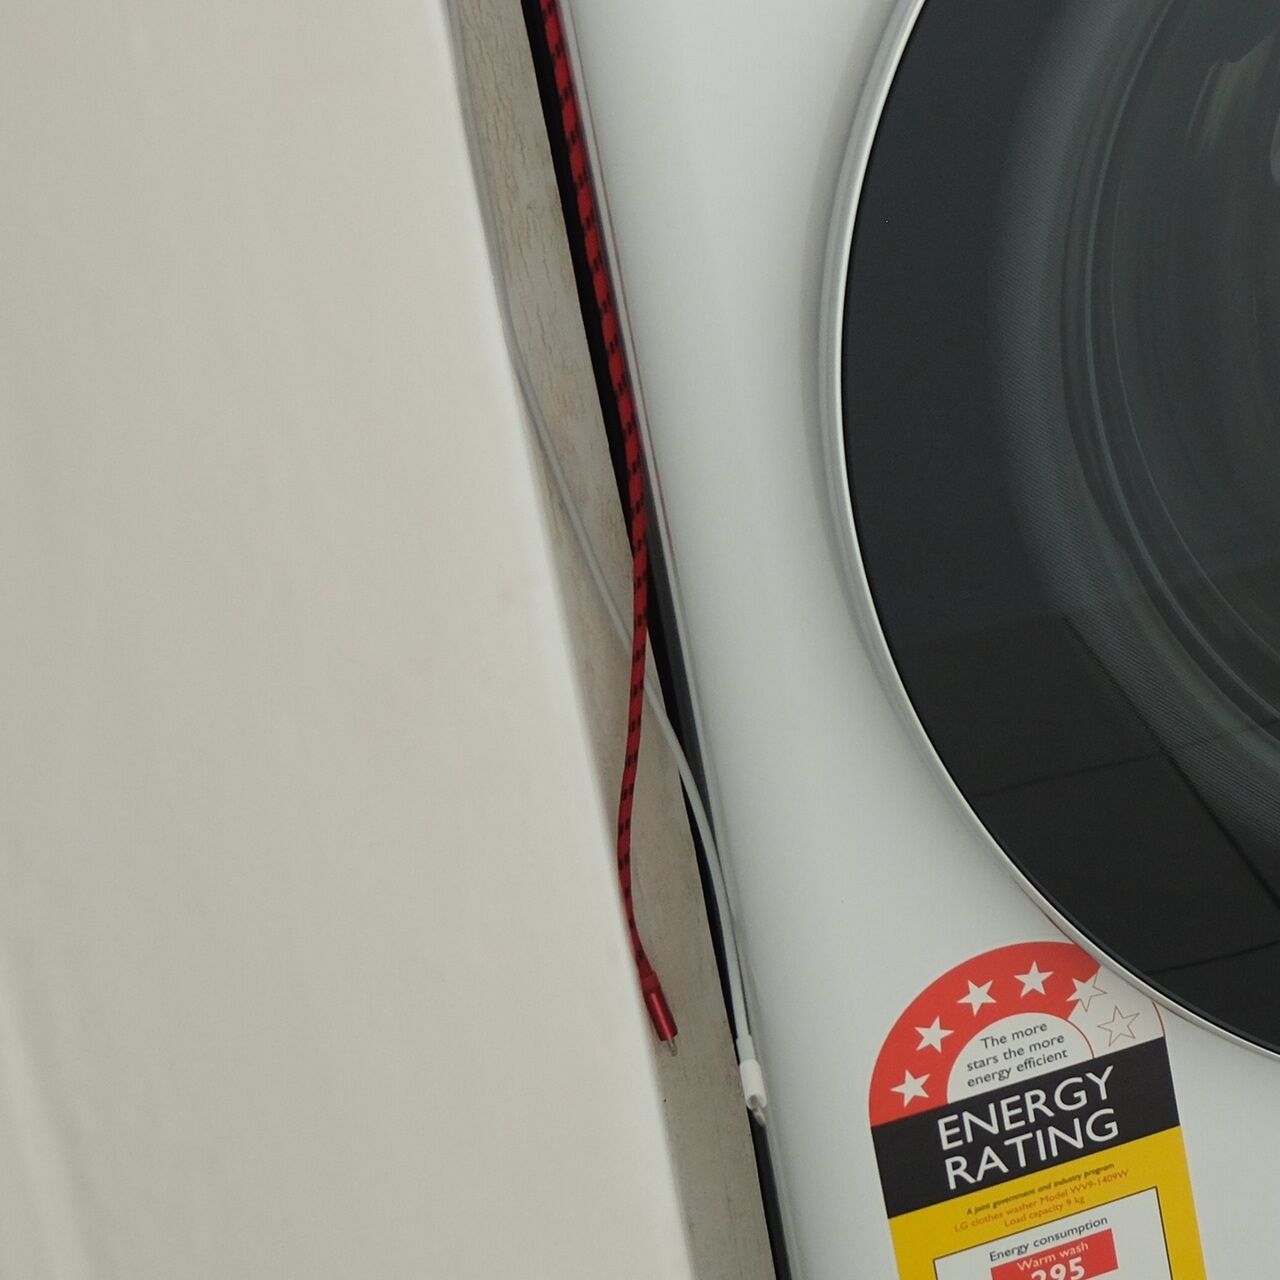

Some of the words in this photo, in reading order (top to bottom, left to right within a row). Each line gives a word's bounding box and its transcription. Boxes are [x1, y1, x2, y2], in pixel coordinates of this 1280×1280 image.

[966, 1054, 999, 1072] stars
[1003, 1045, 1025, 1061] the
[1028, 1033, 1065, 1052] more
[981, 1034, 1007, 1050] The
[1011, 1022, 1048, 1041] more
[966, 1067, 1012, 1088] energy
[1016, 1047, 1068, 1072] efficient
[937, 1065, 1114, 1151] ENERGY
[944, 1108, 1119, 1190] RATING
[974, 1203, 990, 1215] joint
[993, 1188, 1036, 1208] government
[1037, 1183, 1051, 1193] and
[1053, 1174, 1082, 1188] industry
[1084, 1163, 1115, 1178] program
[954, 1223, 969, 1233] LG
[971, 1212, 1003, 1228] clothes
[1005, 1200, 1037, 1215] washer
[1040, 1190, 1068, 1205] Model
[1004, 1215, 1027, 1228] Load
[1029, 1202, 1064, 1220] capacity
[1075, 1195, 1086, 1205] kg
[989, 1242, 1029, 1263] Energy
[1033, 1216, 1108, 1249] consumption
[1017, 1253, 1056, 1272] Warm
[1059, 1240, 1089, 1257] wash
